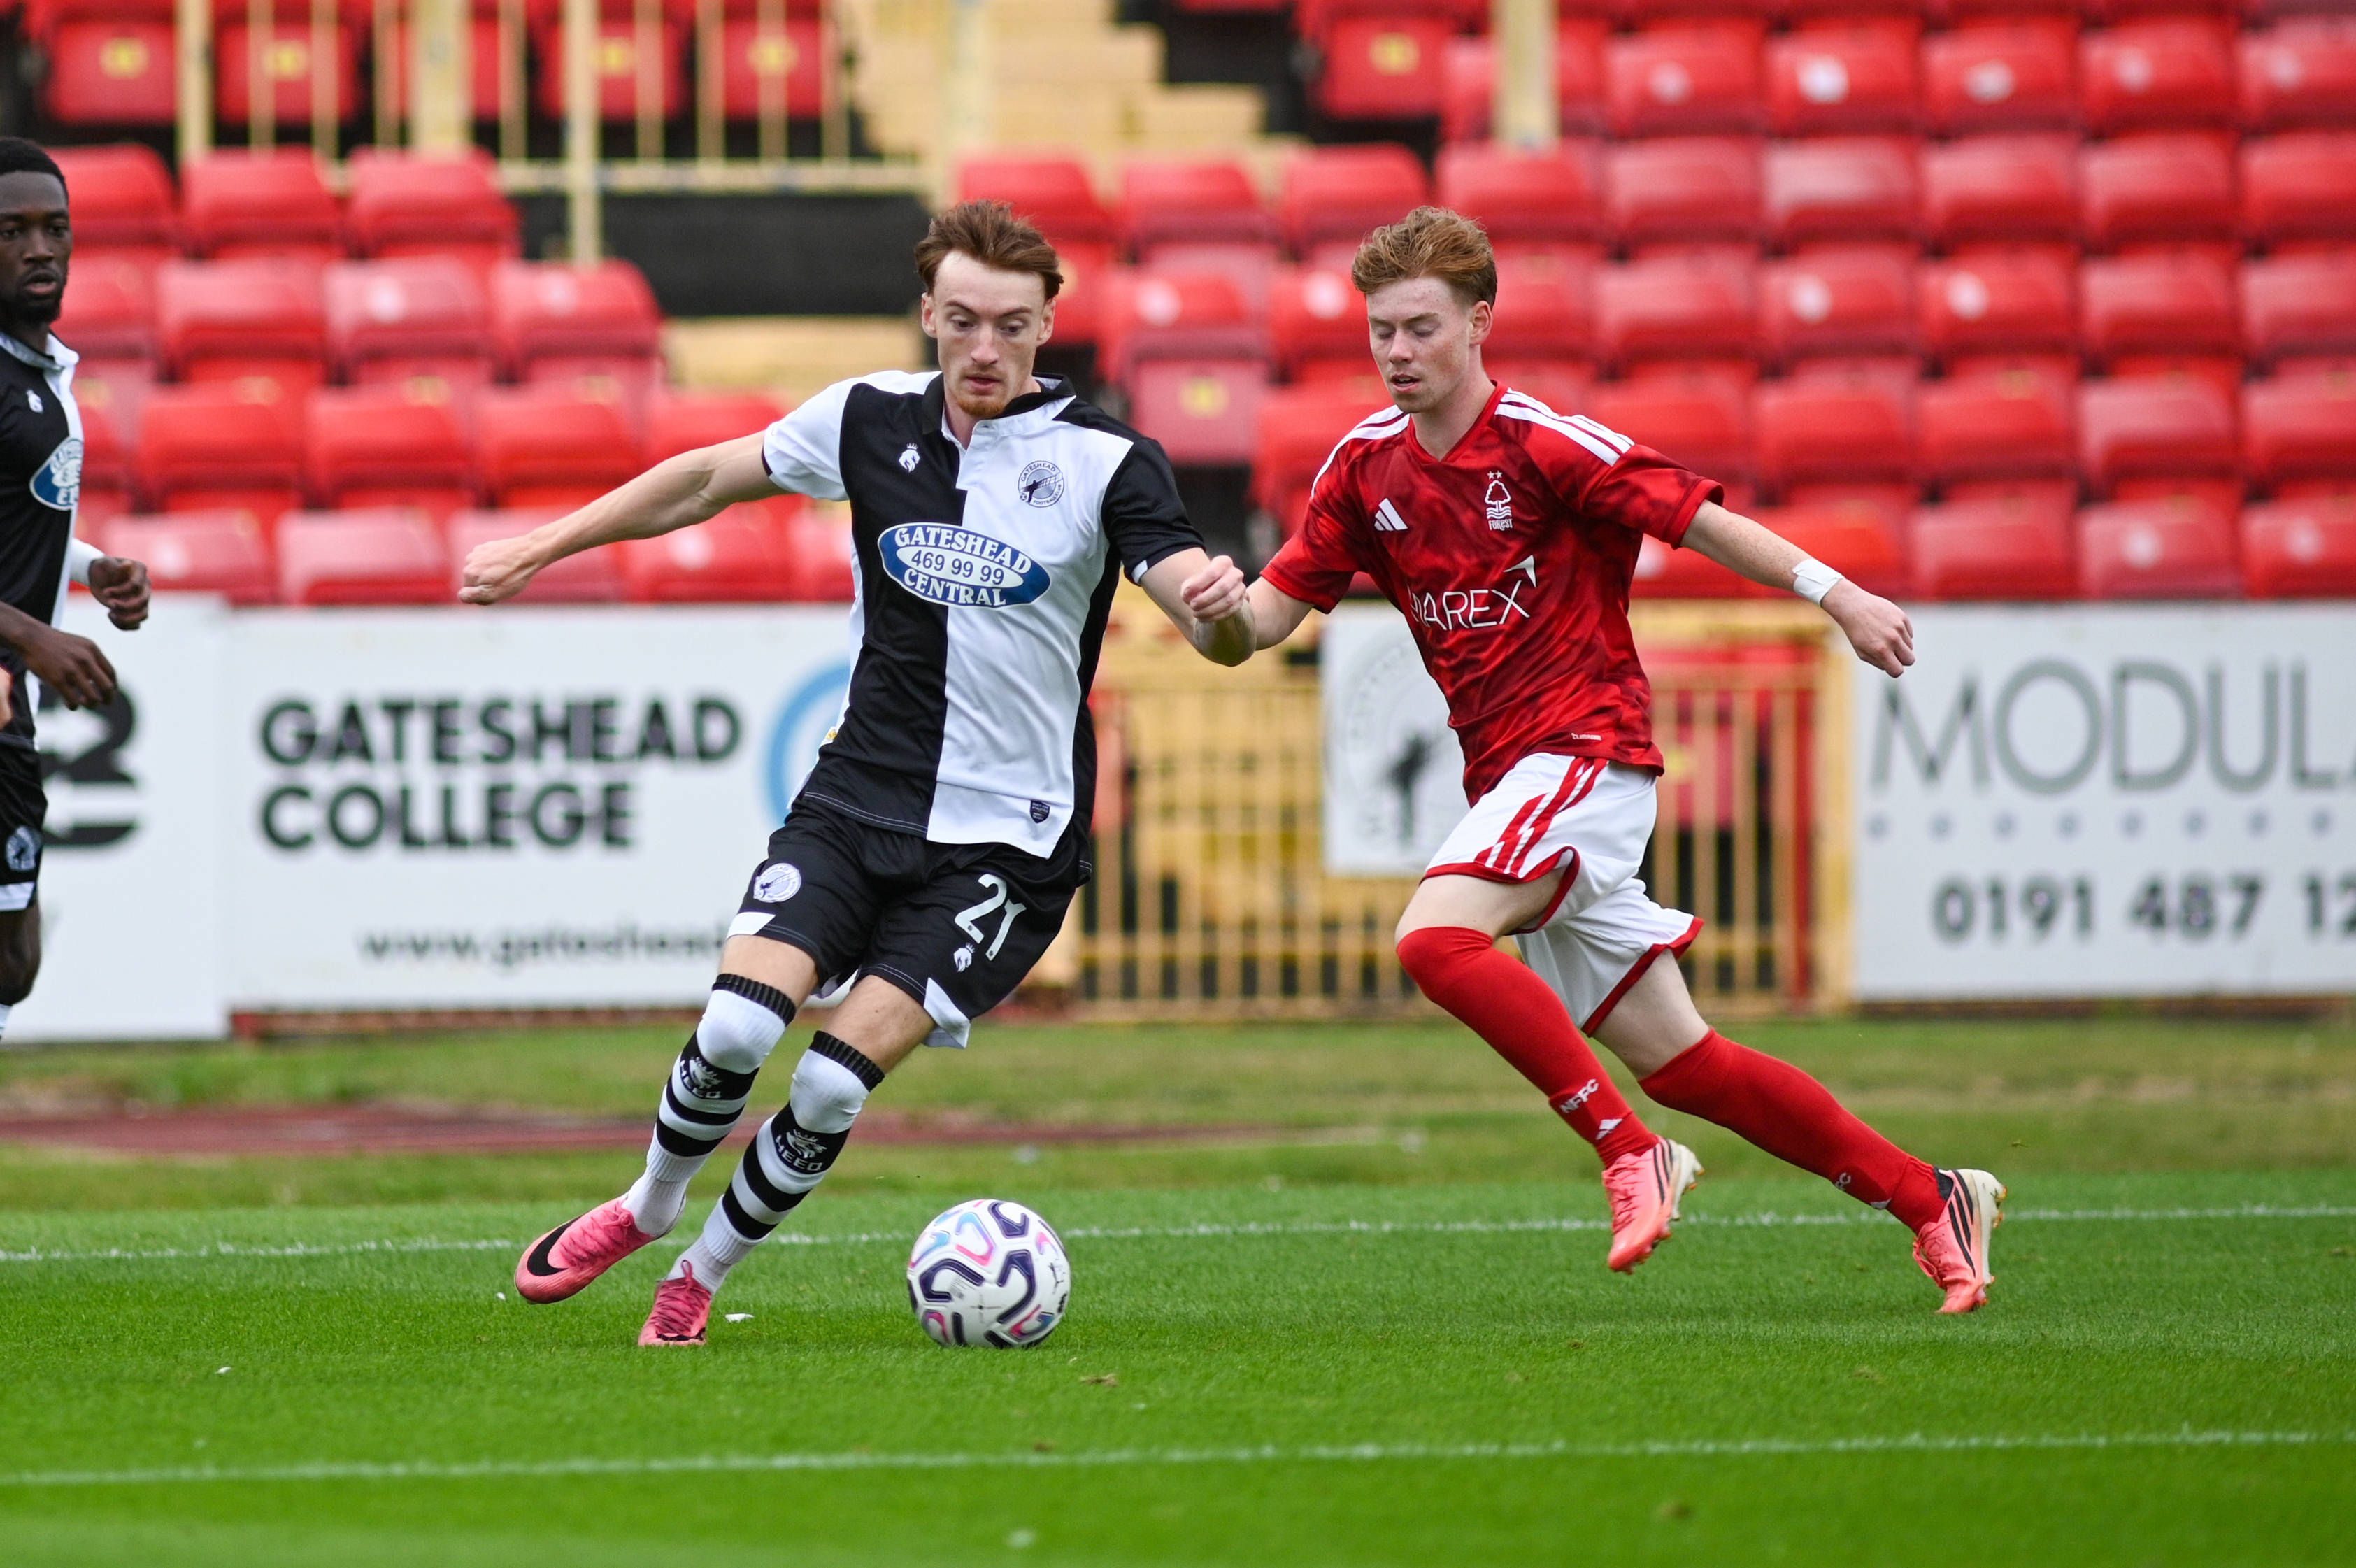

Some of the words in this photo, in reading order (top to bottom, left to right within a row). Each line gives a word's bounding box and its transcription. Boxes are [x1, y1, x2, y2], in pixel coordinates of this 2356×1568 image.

[1021, 462, 1056, 482] GATESHEAD
[894, 526, 1031, 574] GATESHEAD
[911, 550, 944, 571] 469
[951, 558, 973, 578] 99
[980, 565, 1004, 585] 99
[904, 569, 1006, 606] CENTRAL
[259, 697, 742, 767] GATESHEAD
[1870, 660, 2356, 794] MODUL
[259, 783, 633, 850] COLLEGE
[1932, 872, 2094, 944] 0191
[2130, 871, 2262, 944] 487
[1559, 1078, 1599, 1113] NFFC
[776, 1134, 823, 1171] HEED
